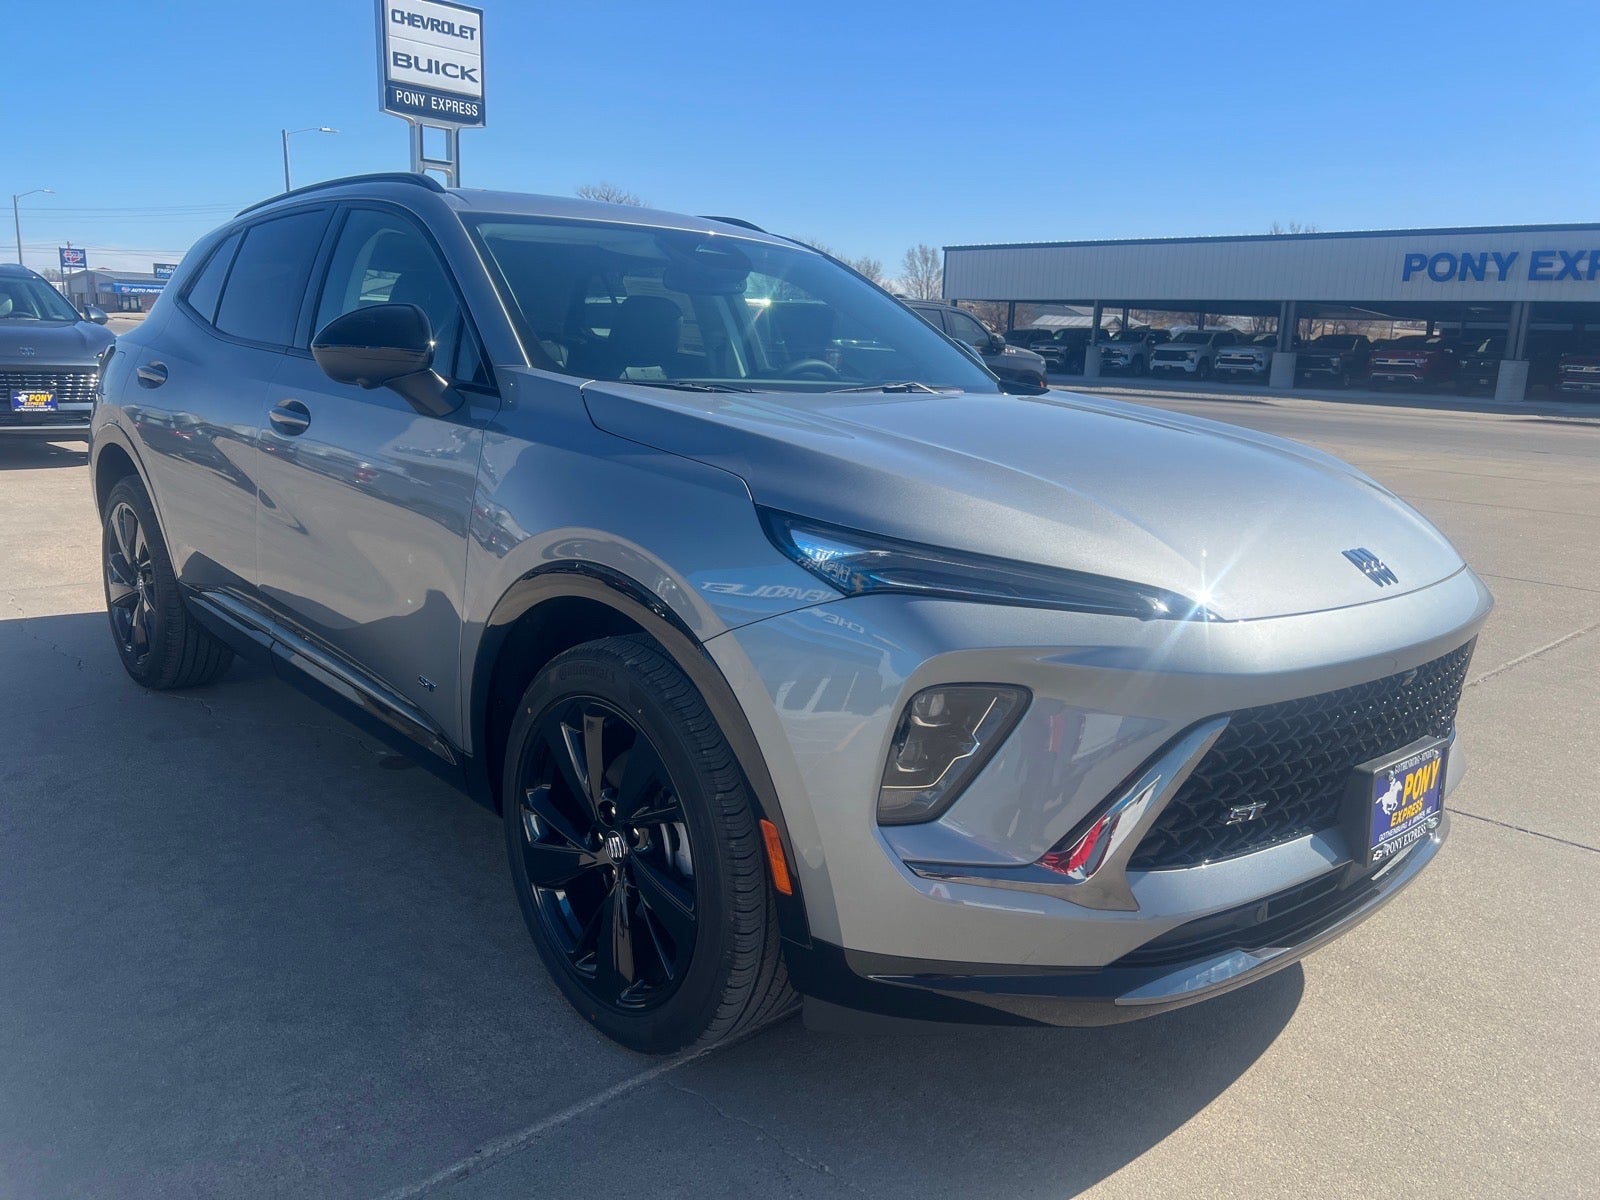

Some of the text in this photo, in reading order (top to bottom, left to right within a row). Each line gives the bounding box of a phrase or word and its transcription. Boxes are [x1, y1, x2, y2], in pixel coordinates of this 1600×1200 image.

[391, 8, 477, 41] CHEVROLET
[392, 51, 479, 83] BUICK
[396, 89, 479, 117] PONY EXPRESS
[1402, 251, 1519, 282] PONY
[28, 393, 53, 402] PONY
[418, 674, 437, 692] ST
[1401, 757, 1441, 806] PONY
[1390, 797, 1424, 827] EXPRESS
[1403, 822, 1427, 846] EXPRESS
